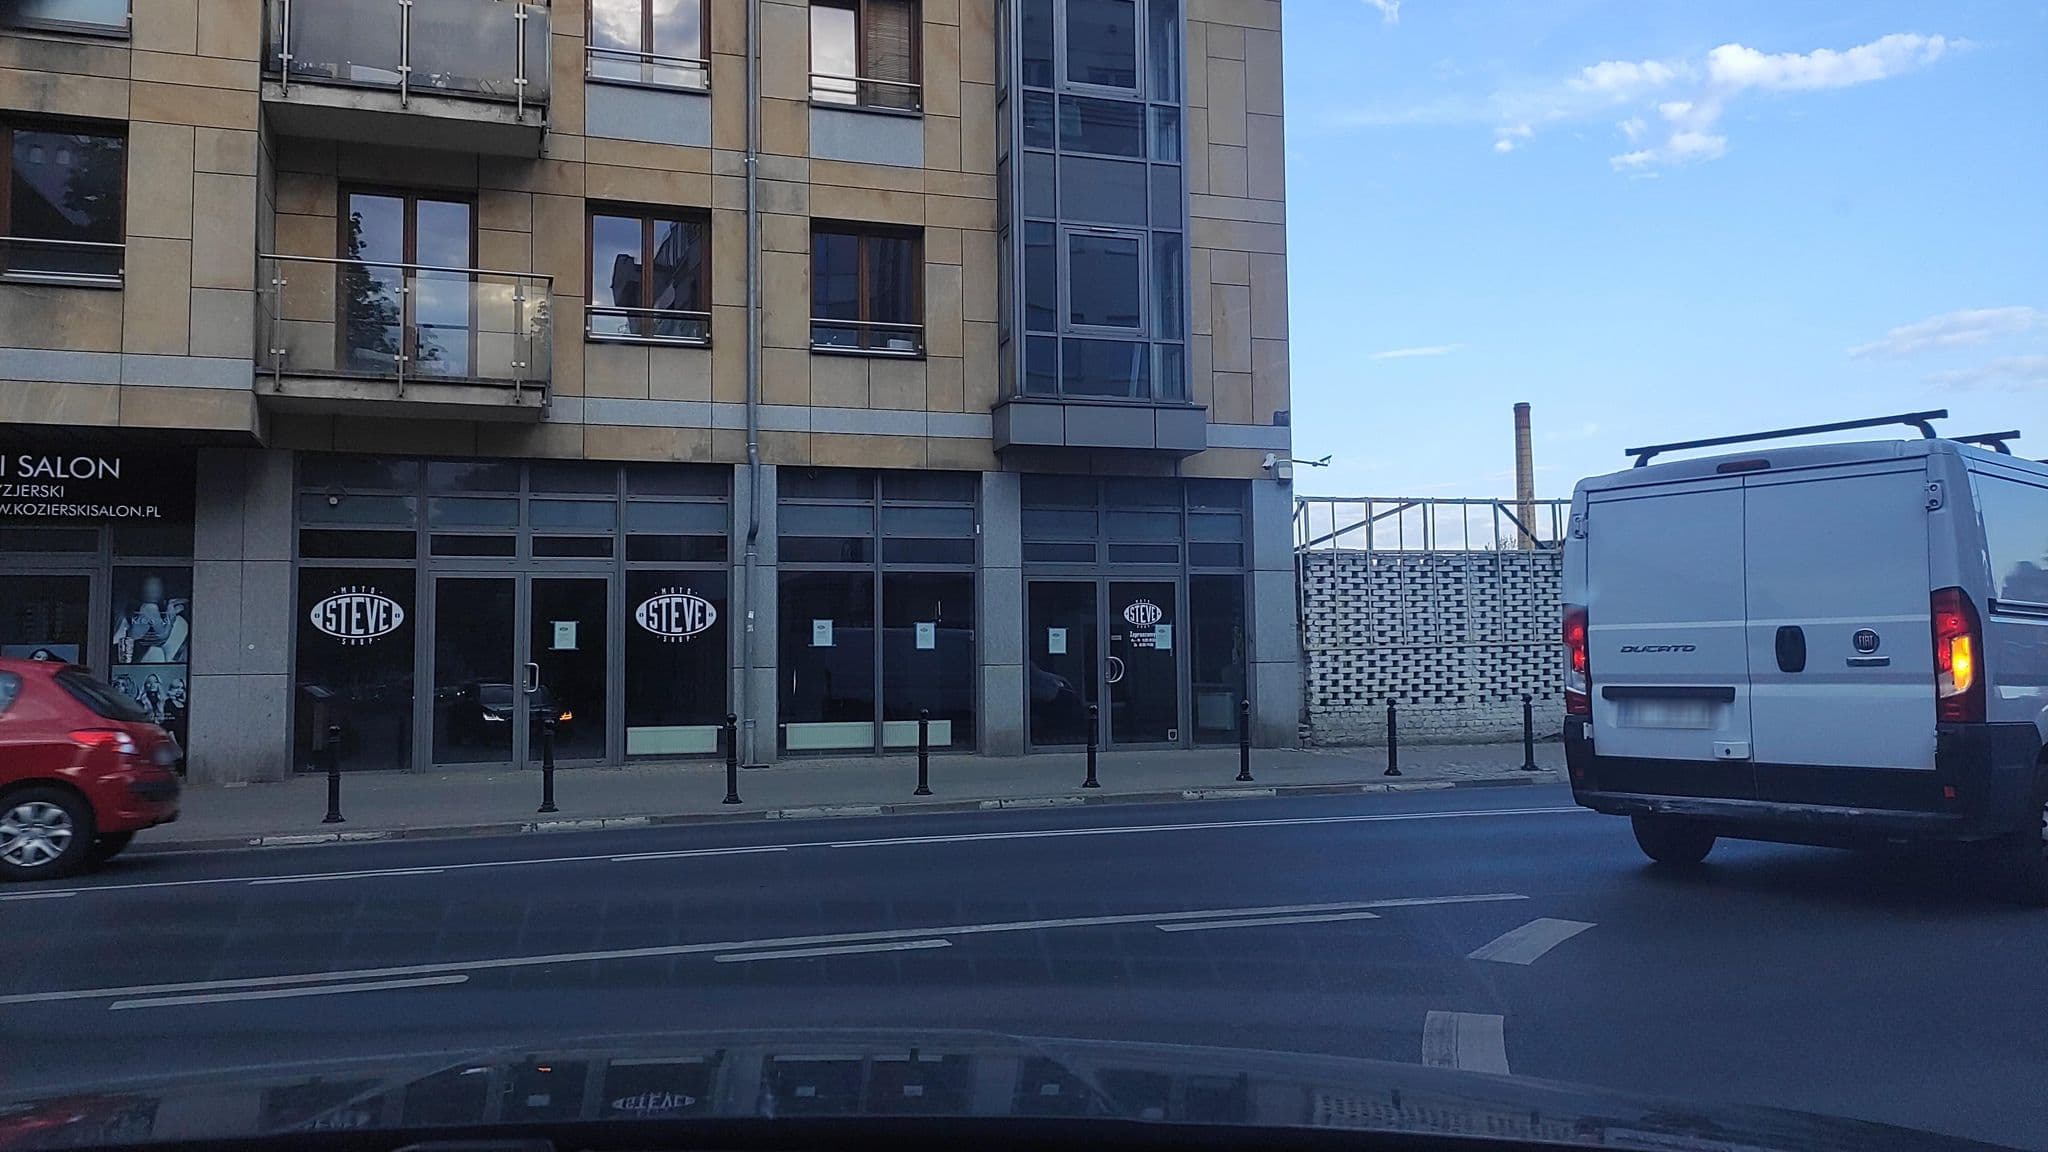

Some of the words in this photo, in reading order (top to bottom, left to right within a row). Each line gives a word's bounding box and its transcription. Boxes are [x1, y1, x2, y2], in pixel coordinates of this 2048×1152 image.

[17, 455, 120, 479] SALON
[326, 597, 389, 634] STEVE
[649, 597, 703, 632] STEVE
[1129, 605, 1156, 623] STEVE
[1620, 645, 1696, 653] DUCATO
[1858, 635, 1873, 648] FIAT
